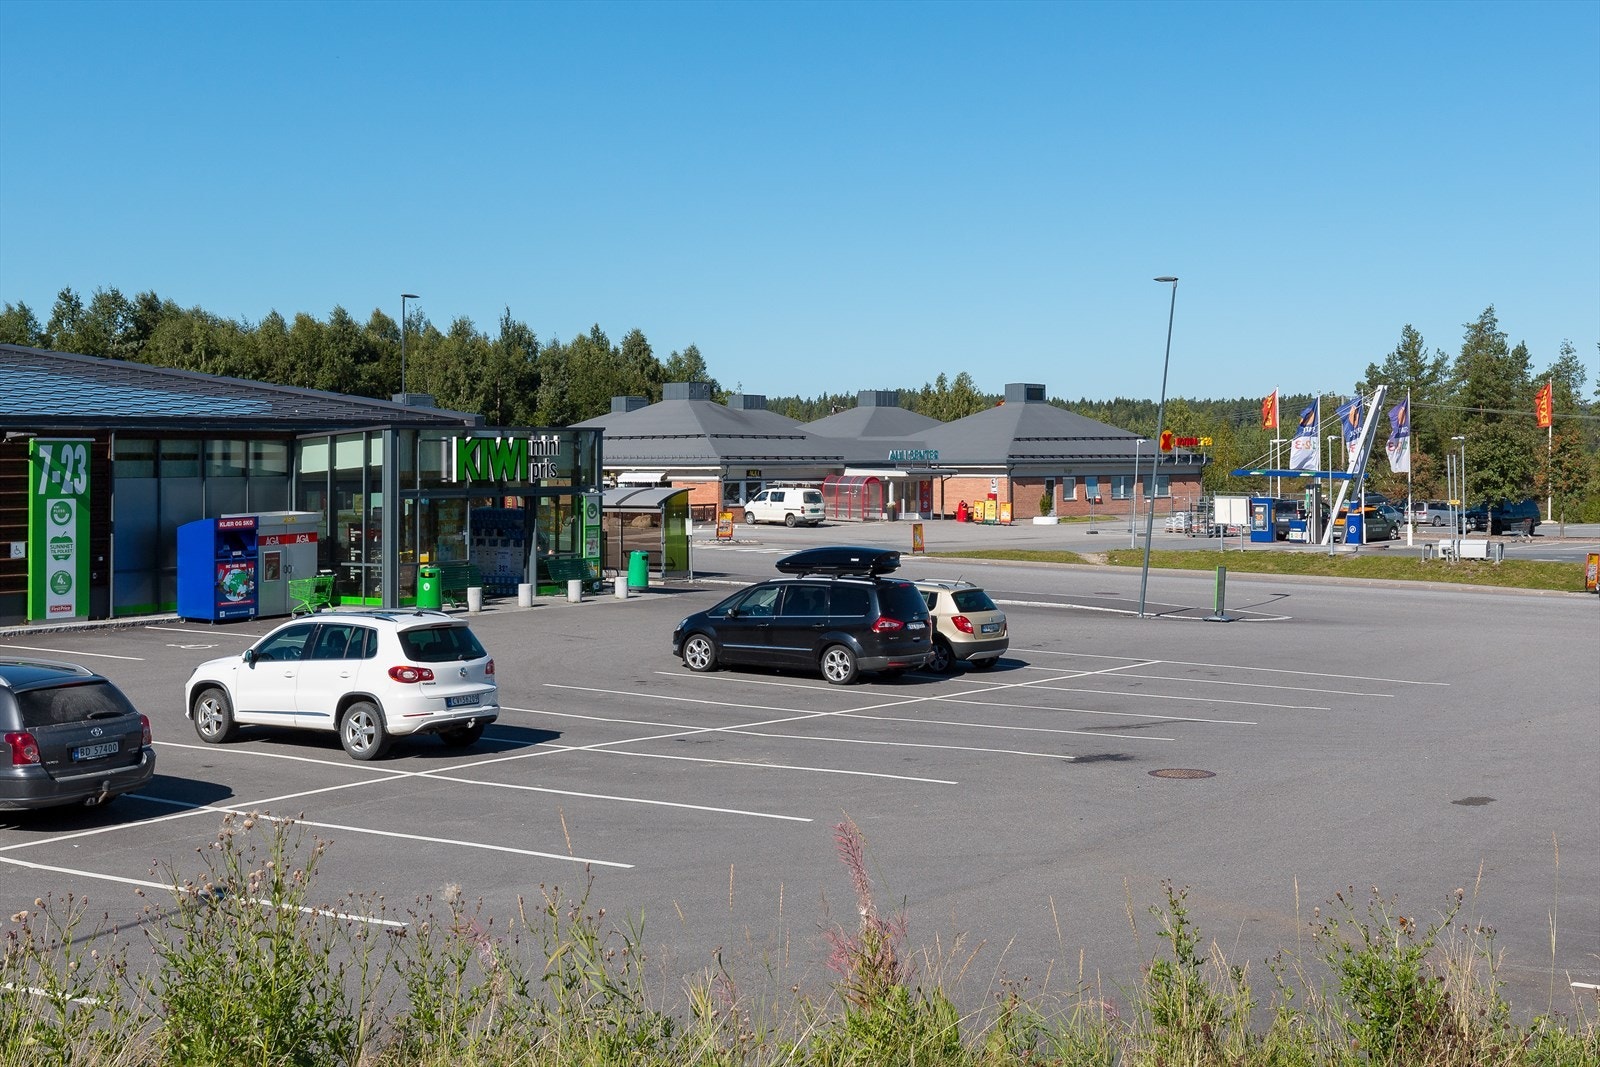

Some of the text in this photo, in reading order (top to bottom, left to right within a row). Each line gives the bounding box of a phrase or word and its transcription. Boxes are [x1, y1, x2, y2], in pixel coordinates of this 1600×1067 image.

[531, 435, 560, 456] mini
[38, 443, 87, 495] 7-23
[456, 437, 528, 481] KIWI
[531, 457, 558, 483] pris
[265, 536, 280, 546] AGA
[295, 534, 310, 544] AGA
[80, 747, 91, 757] BD
[94, 743, 118, 755] 57400
